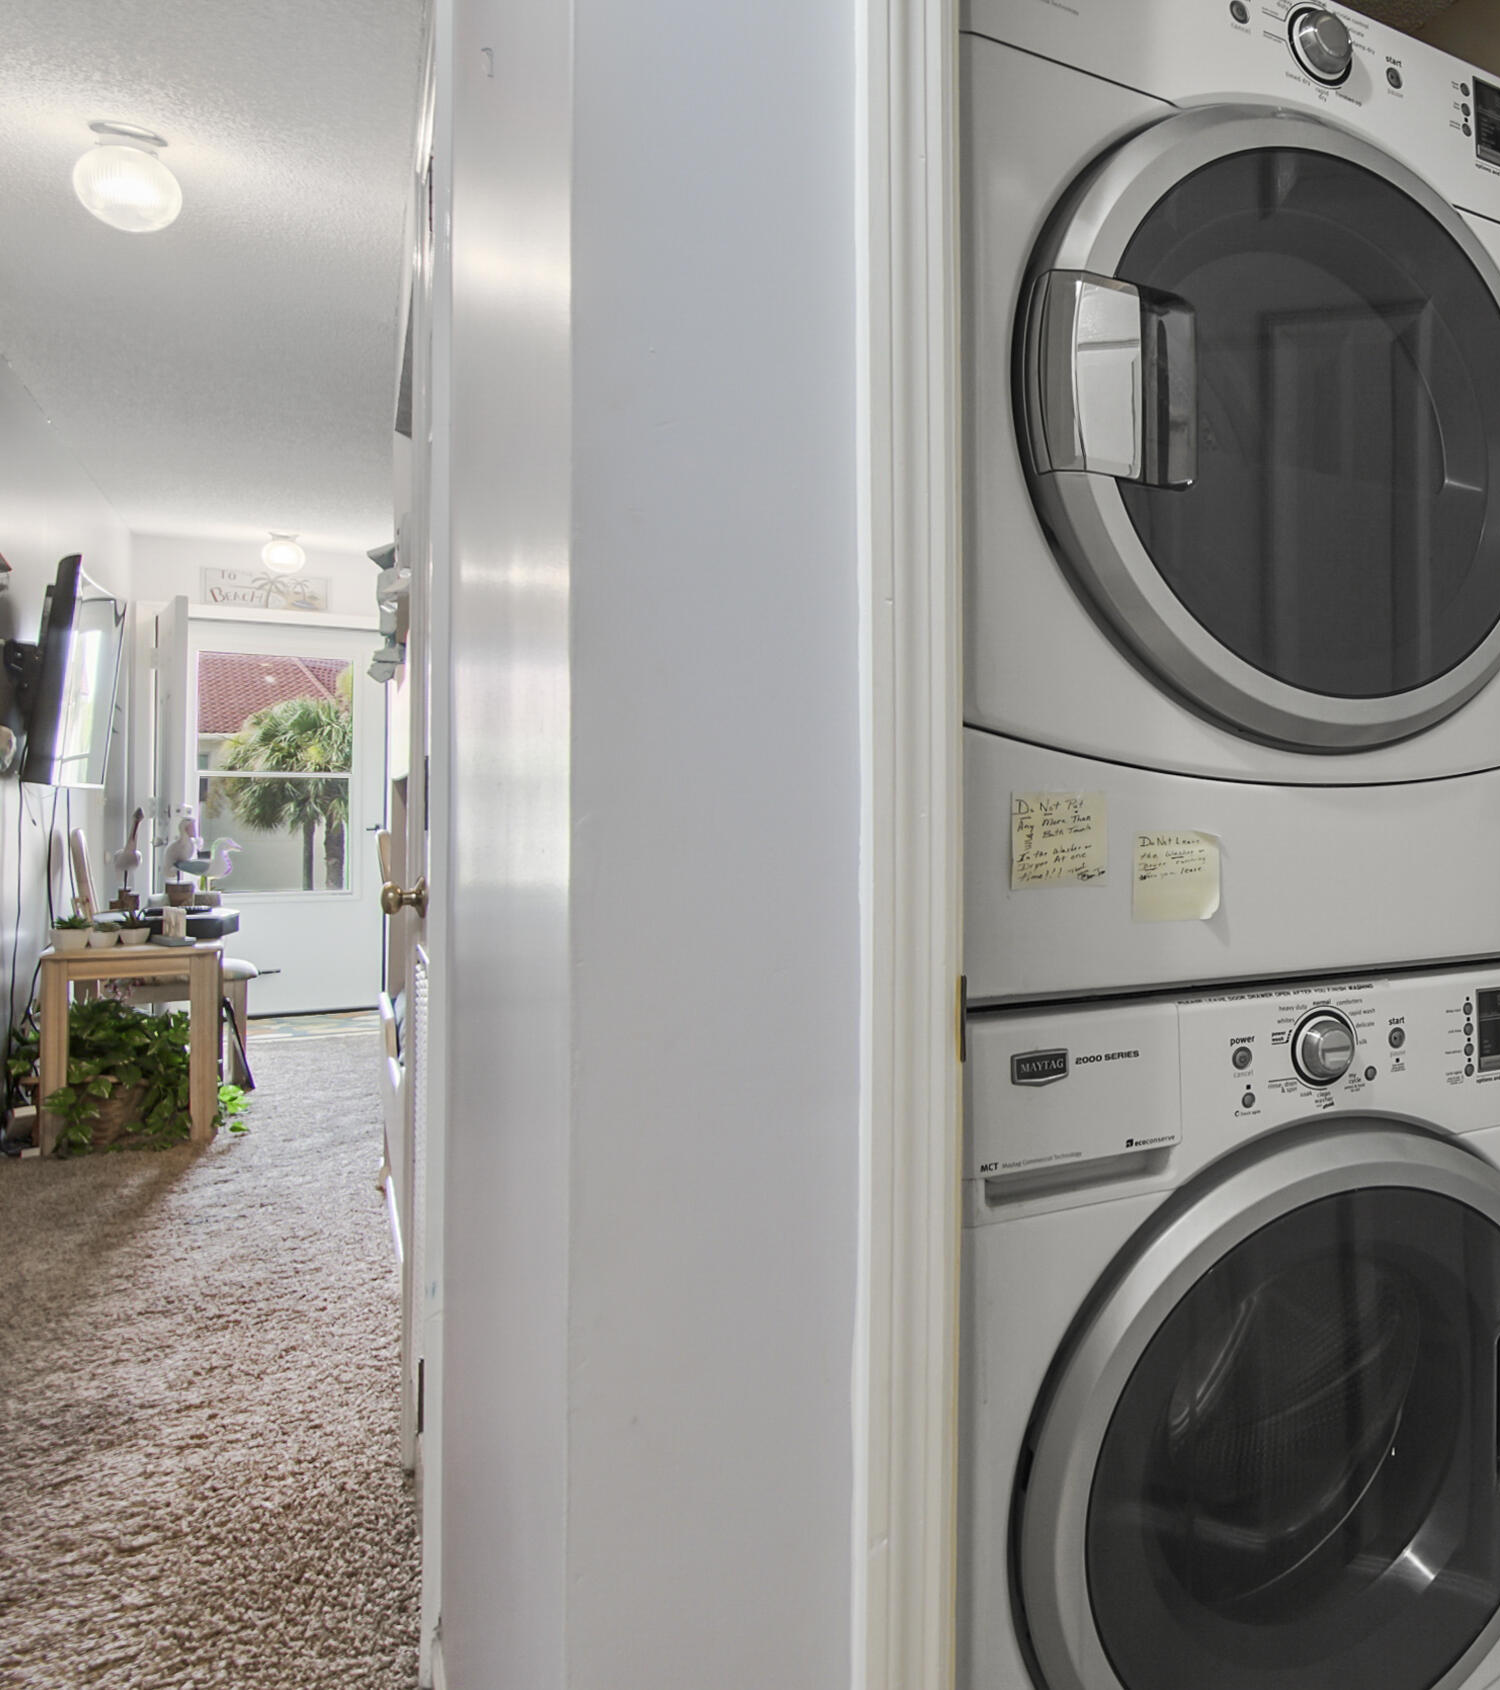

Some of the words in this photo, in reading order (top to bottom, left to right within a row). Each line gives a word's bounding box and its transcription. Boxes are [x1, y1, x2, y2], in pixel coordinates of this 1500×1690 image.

[1385, 55, 1403, 68] start
[1313, 998, 1332, 1006] normal
[1388, 1016, 1405, 1026] start
[1230, 1035, 1255, 1047] power
[1075, 1054, 1102, 1065] 2000
[1104, 1050, 1139, 1061] SERIES
[1020, 1057, 1064, 1073] MAYTAG
[1233, 1069, 1254, 1079] cancel
[1134, 1135, 1176, 1147] ecoconserve
[980, 1161, 999, 1172] MCT
[1002, 1160, 1021, 1169] Maytag
